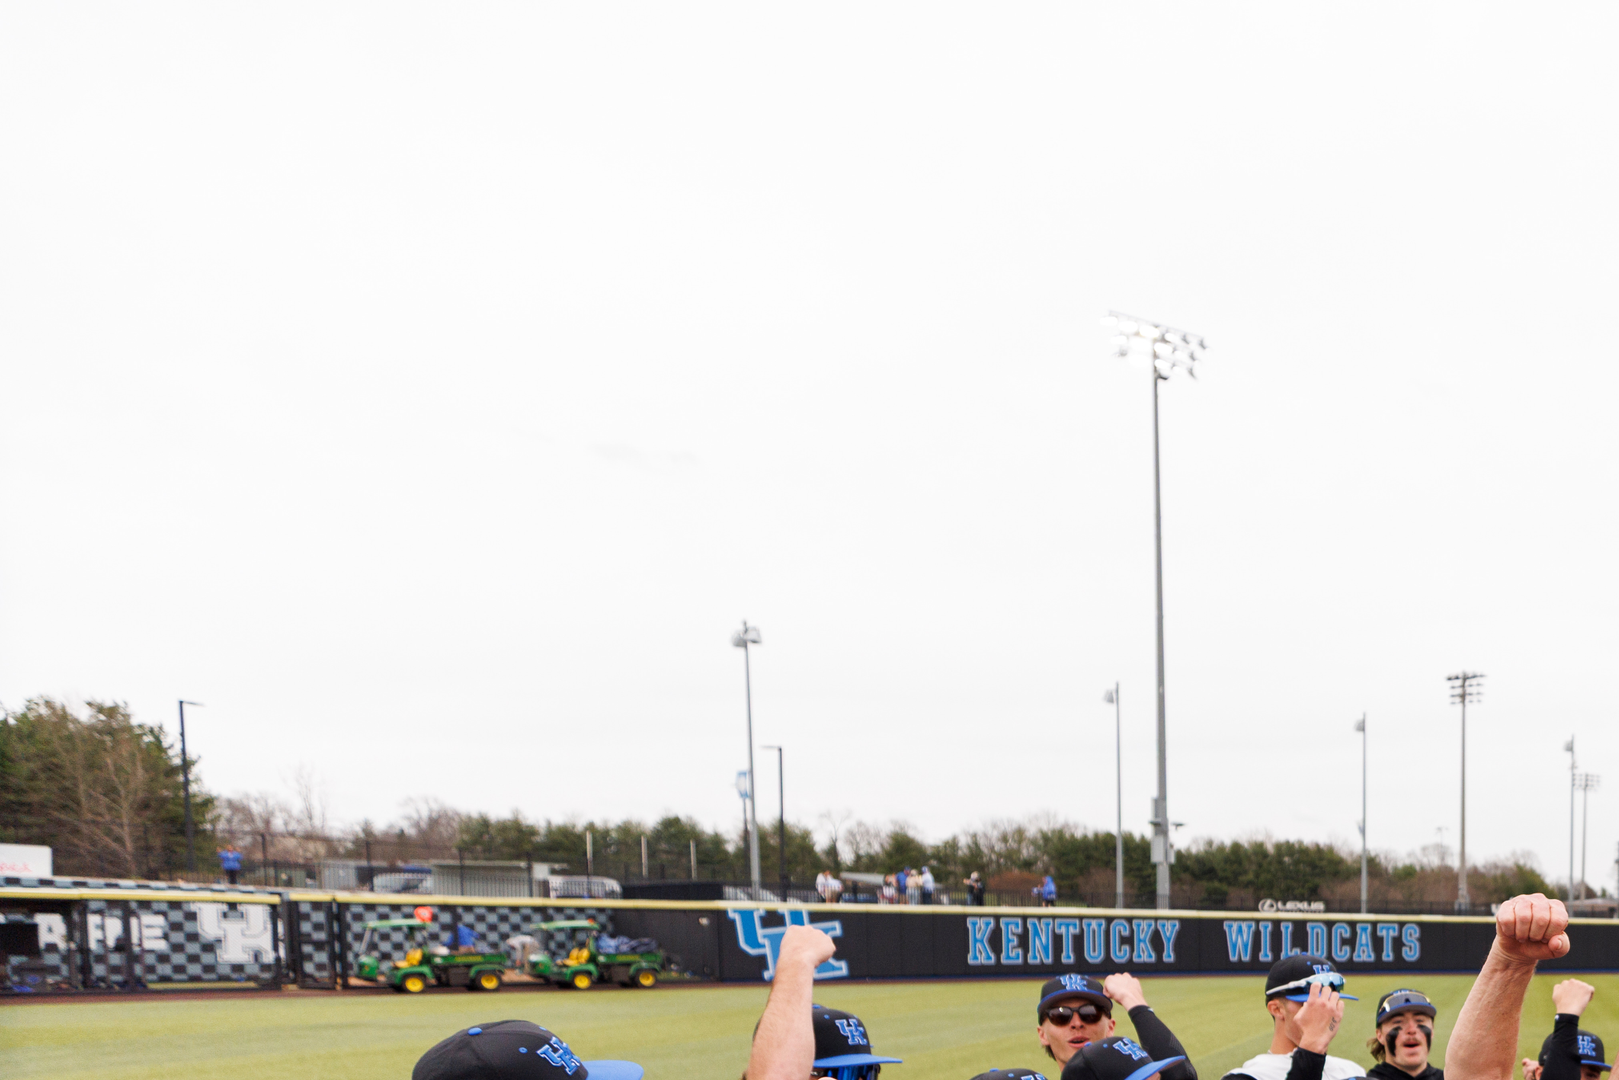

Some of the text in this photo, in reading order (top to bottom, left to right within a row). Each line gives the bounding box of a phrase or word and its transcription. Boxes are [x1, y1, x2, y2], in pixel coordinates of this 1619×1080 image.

[967, 917, 1422, 966] KENTUCKY WILDCATS
[835, 1019, 868, 1046] UK
